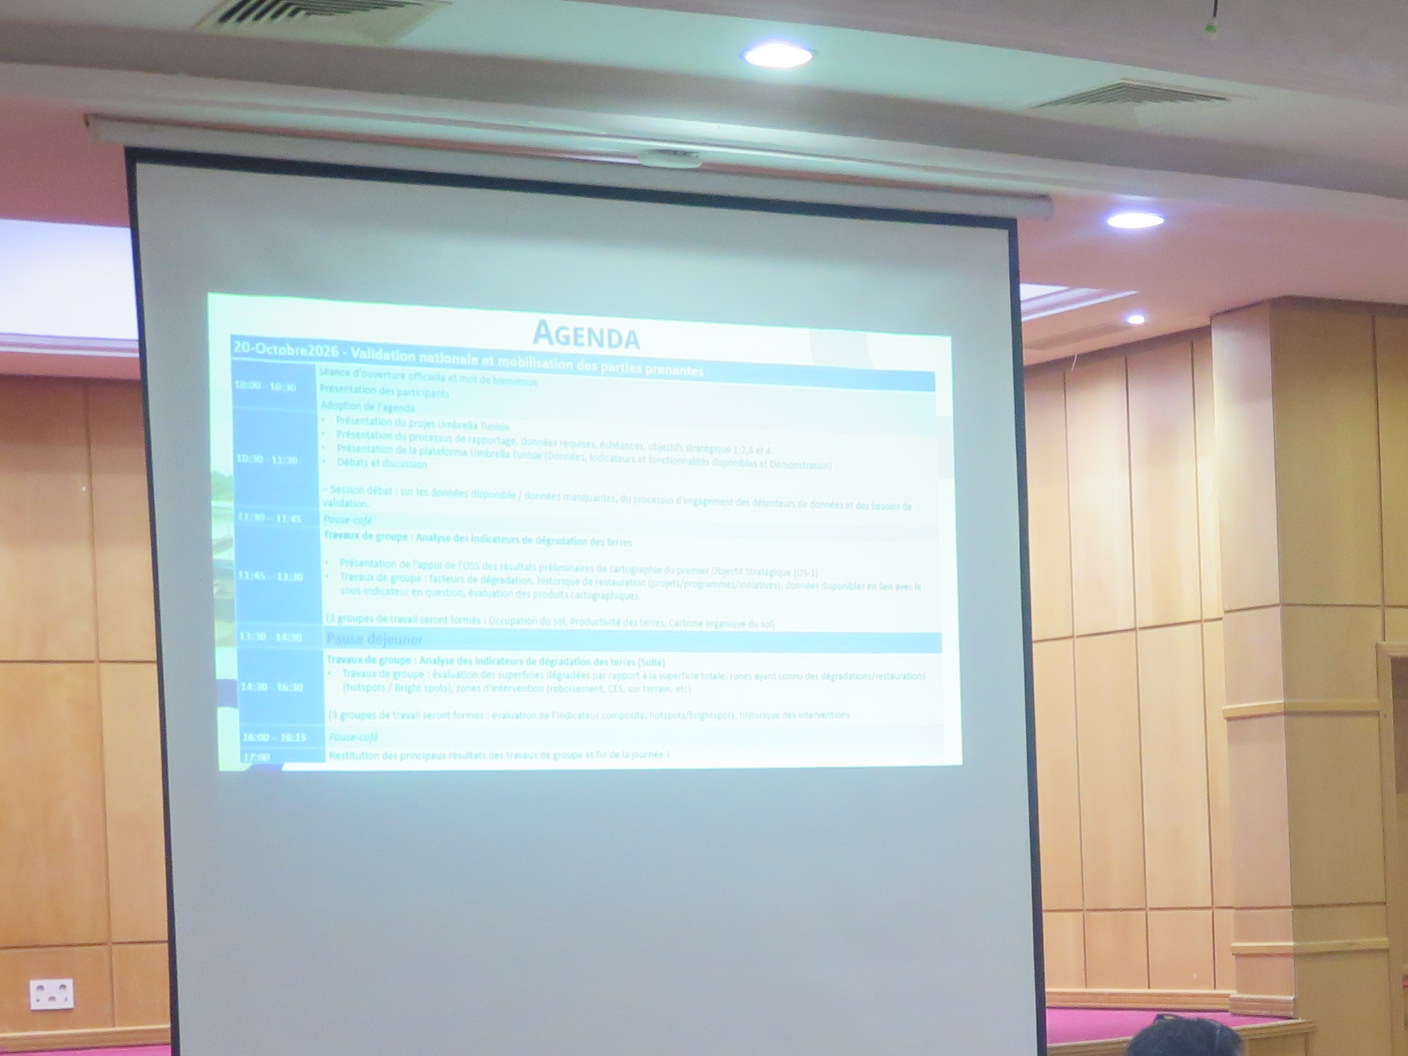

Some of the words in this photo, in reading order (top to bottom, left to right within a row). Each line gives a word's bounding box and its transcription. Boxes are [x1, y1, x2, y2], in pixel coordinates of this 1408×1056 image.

[234, 341, 339, 358] 20-Octobre2026
[350, 347, 416, 362] Validation
[418, 350, 478, 365] nationale
[481, 355, 494, 366] et
[497, 355, 573, 370] mobilisation
[576, 359, 597, 371] des
[600, 360, 642, 376] parties
[644, 364, 704, 379] prenantes
[319, 366, 351, 377] Séance
[352, 368, 406, 380] d'ouverture
[408, 371, 446, 382] officielle
[447, 373, 457, 382] et
[459, 374, 477, 383] mot
[479, 374, 491, 384] de
[492, 375, 538, 386] bienvenue
[319, 383, 377, 395] Présentation
[378, 386, 394, 396] des
[396, 386, 450, 400] participants
[320, 400, 362, 413] Adoption
[363, 401, 376, 411] de
[377, 402, 416, 415] l'agenda
[335, 414, 392, 426] Présentation
[394, 417, 406, 427] du
[407, 417, 435, 430] projet
[437, 419, 478, 430] Umbrella
[480, 420, 510, 431] Tunisie
[335, 428, 393, 440] Présentation
[394, 431, 407, 441] du
[408, 433, 453, 444] processus
[454, 433, 466, 443] de
[520, 436, 557, 446] données
[647, 441, 683, 453] objectifs
[684, 443, 731, 455] stratégique
[754, 446, 764, 455] et
[336, 456, 368, 467] Débats
[370, 458, 380, 467] et
[382, 458, 428, 469] discussion
[275, 513, 302, 523] 11:45
[323, 514, 373, 525] Pause-café
[324, 529, 360, 539] Travaux
[361, 530, 374, 540] de
[375, 532, 408, 543] groupe
[415, 532, 451, 544] Analyse
[452, 533, 469, 542] des
[470, 533, 520, 544] indicateurs
[521, 534, 533, 544] de
[534, 535, 588, 547] dégradation
[589, 536, 605, 546] des
[606, 537, 632, 546] terres
[238, 570, 266, 580] 11:45
[276, 571, 304, 581] 13:30
[339, 585, 408, 596] sous-indicateur
[467, 588, 514, 598] évaluation
[515, 589, 531, 598] des
[532, 589, 569, 601] produits
[336, 614, 374, 624] groupes
[376, 613, 388, 622] de
[389, 613, 418, 623] travail
[419, 614, 448, 623] seront
[449, 614, 481, 623] formés
[488, 614, 537, 626] Occupation
[539, 615, 551, 624] du
[569, 615, 621, 625] Productivité
[622, 616, 637, 625] des
[668, 617, 704, 626] Carbone
[705, 617, 747, 629] organique
[747, 618, 759, 627] du
[760, 618, 776, 629] sol)
[239, 631, 267, 641] 13:30
[275, 632, 303, 641] 14:30
[325, 633, 364, 644] Pause
[366, 631, 424, 648] déjeuner
[327, 654, 363, 664] Travaux
[364, 654, 377, 664] de
[378, 656, 412, 666] groupe
[419, 655, 455, 666] Analyse
[456, 655, 472, 665] des
[474, 655, 523, 665] indicateurs
[525, 656, 537, 665] de
[538, 656, 591, 667] dégradation
[593, 656, 608, 666] des
[610, 657, 635, 666] terres
[637, 657, 666, 668] (Suite)
[240, 682, 268, 691] 14:30
[276, 682, 304, 691] 16:30
[342, 682, 386, 694] (hotspots
[394, 682, 421, 694] Bright
[455, 684, 481, 692] zones
[483, 683, 544, 692] d'intervention
[627, 685, 640, 693] sur
[339, 711, 377, 721] groupes
[378, 710, 391, 719] de
[392, 710, 421, 719] travail
[422, 710, 451, 719] seront
[452, 710, 484, 719] formés
[490, 710, 537, 719] évaluation
[538, 710, 550, 719] de
[550, 710, 599, 719] l'indicateur
[738, 710, 780, 721] historique
[781, 710, 796, 719] des
[797, 710, 850, 719] interventions
[243, 732, 270, 742] 16:00
[329, 732, 379, 743] Pause-café
[329, 750, 380, 760] Restitution
[381, 750, 397, 760] des
[399, 750, 446, 762] principaux
[448, 750, 486, 759] résultats
[488, 750, 504, 759] des
[505, 750, 538, 759] travaux
[539, 750, 551, 759] de
[552, 751, 583, 761] groupe
[584, 750, 594, 759] et
[595, 749, 607, 758] fin
[608, 749, 620, 758] de
[621, 749, 630, 758] la
[630, 749, 664, 760] journée
